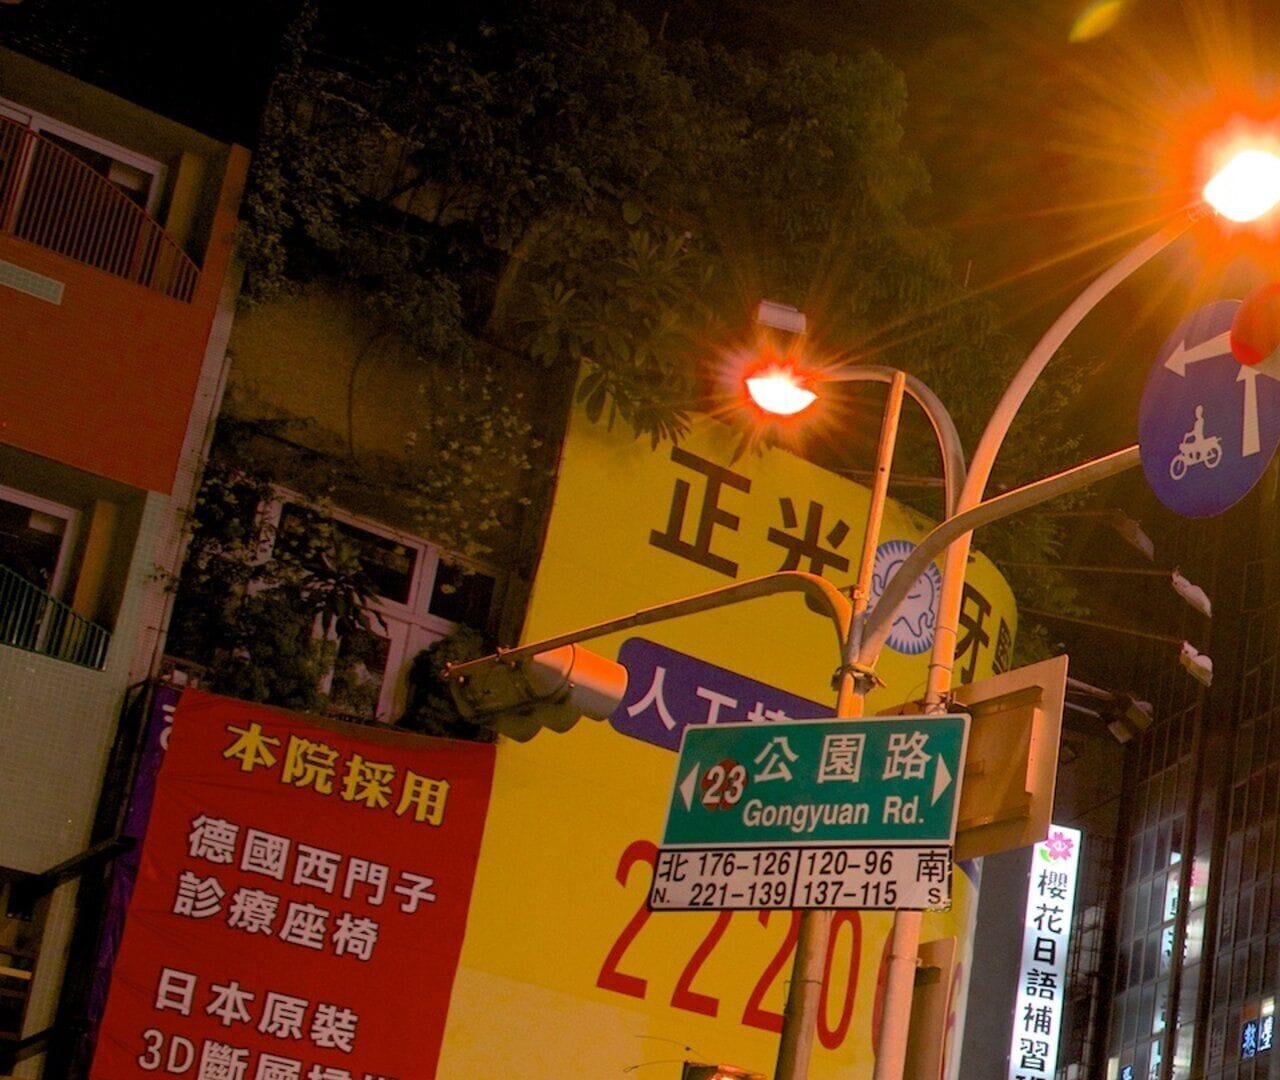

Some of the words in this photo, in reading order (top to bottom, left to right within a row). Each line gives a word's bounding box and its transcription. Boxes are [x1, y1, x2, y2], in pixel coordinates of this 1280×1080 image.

[627, 667, 799, 732] 人工
[222, 721, 450, 827] 本院採用
[702, 765, 746, 806] 23
[753, 731, 934, 784] 公園路
[742, 799, 869, 833] Gongyuan
[883, 796, 924, 826] Rd.
[188, 814, 437, 915] 德國西門子
[659, 855, 686, 883] 北
[699, 851, 791, 879] 176-126
[806, 851, 893, 876] 120-96
[917, 851, 947, 884] 南
[688, 883, 787, 907] 221-139
[803, 881, 897, 906] 137-115
[172, 870, 380, 961] 診療座椅
[155, 967, 359, 1054] 日本原裝
